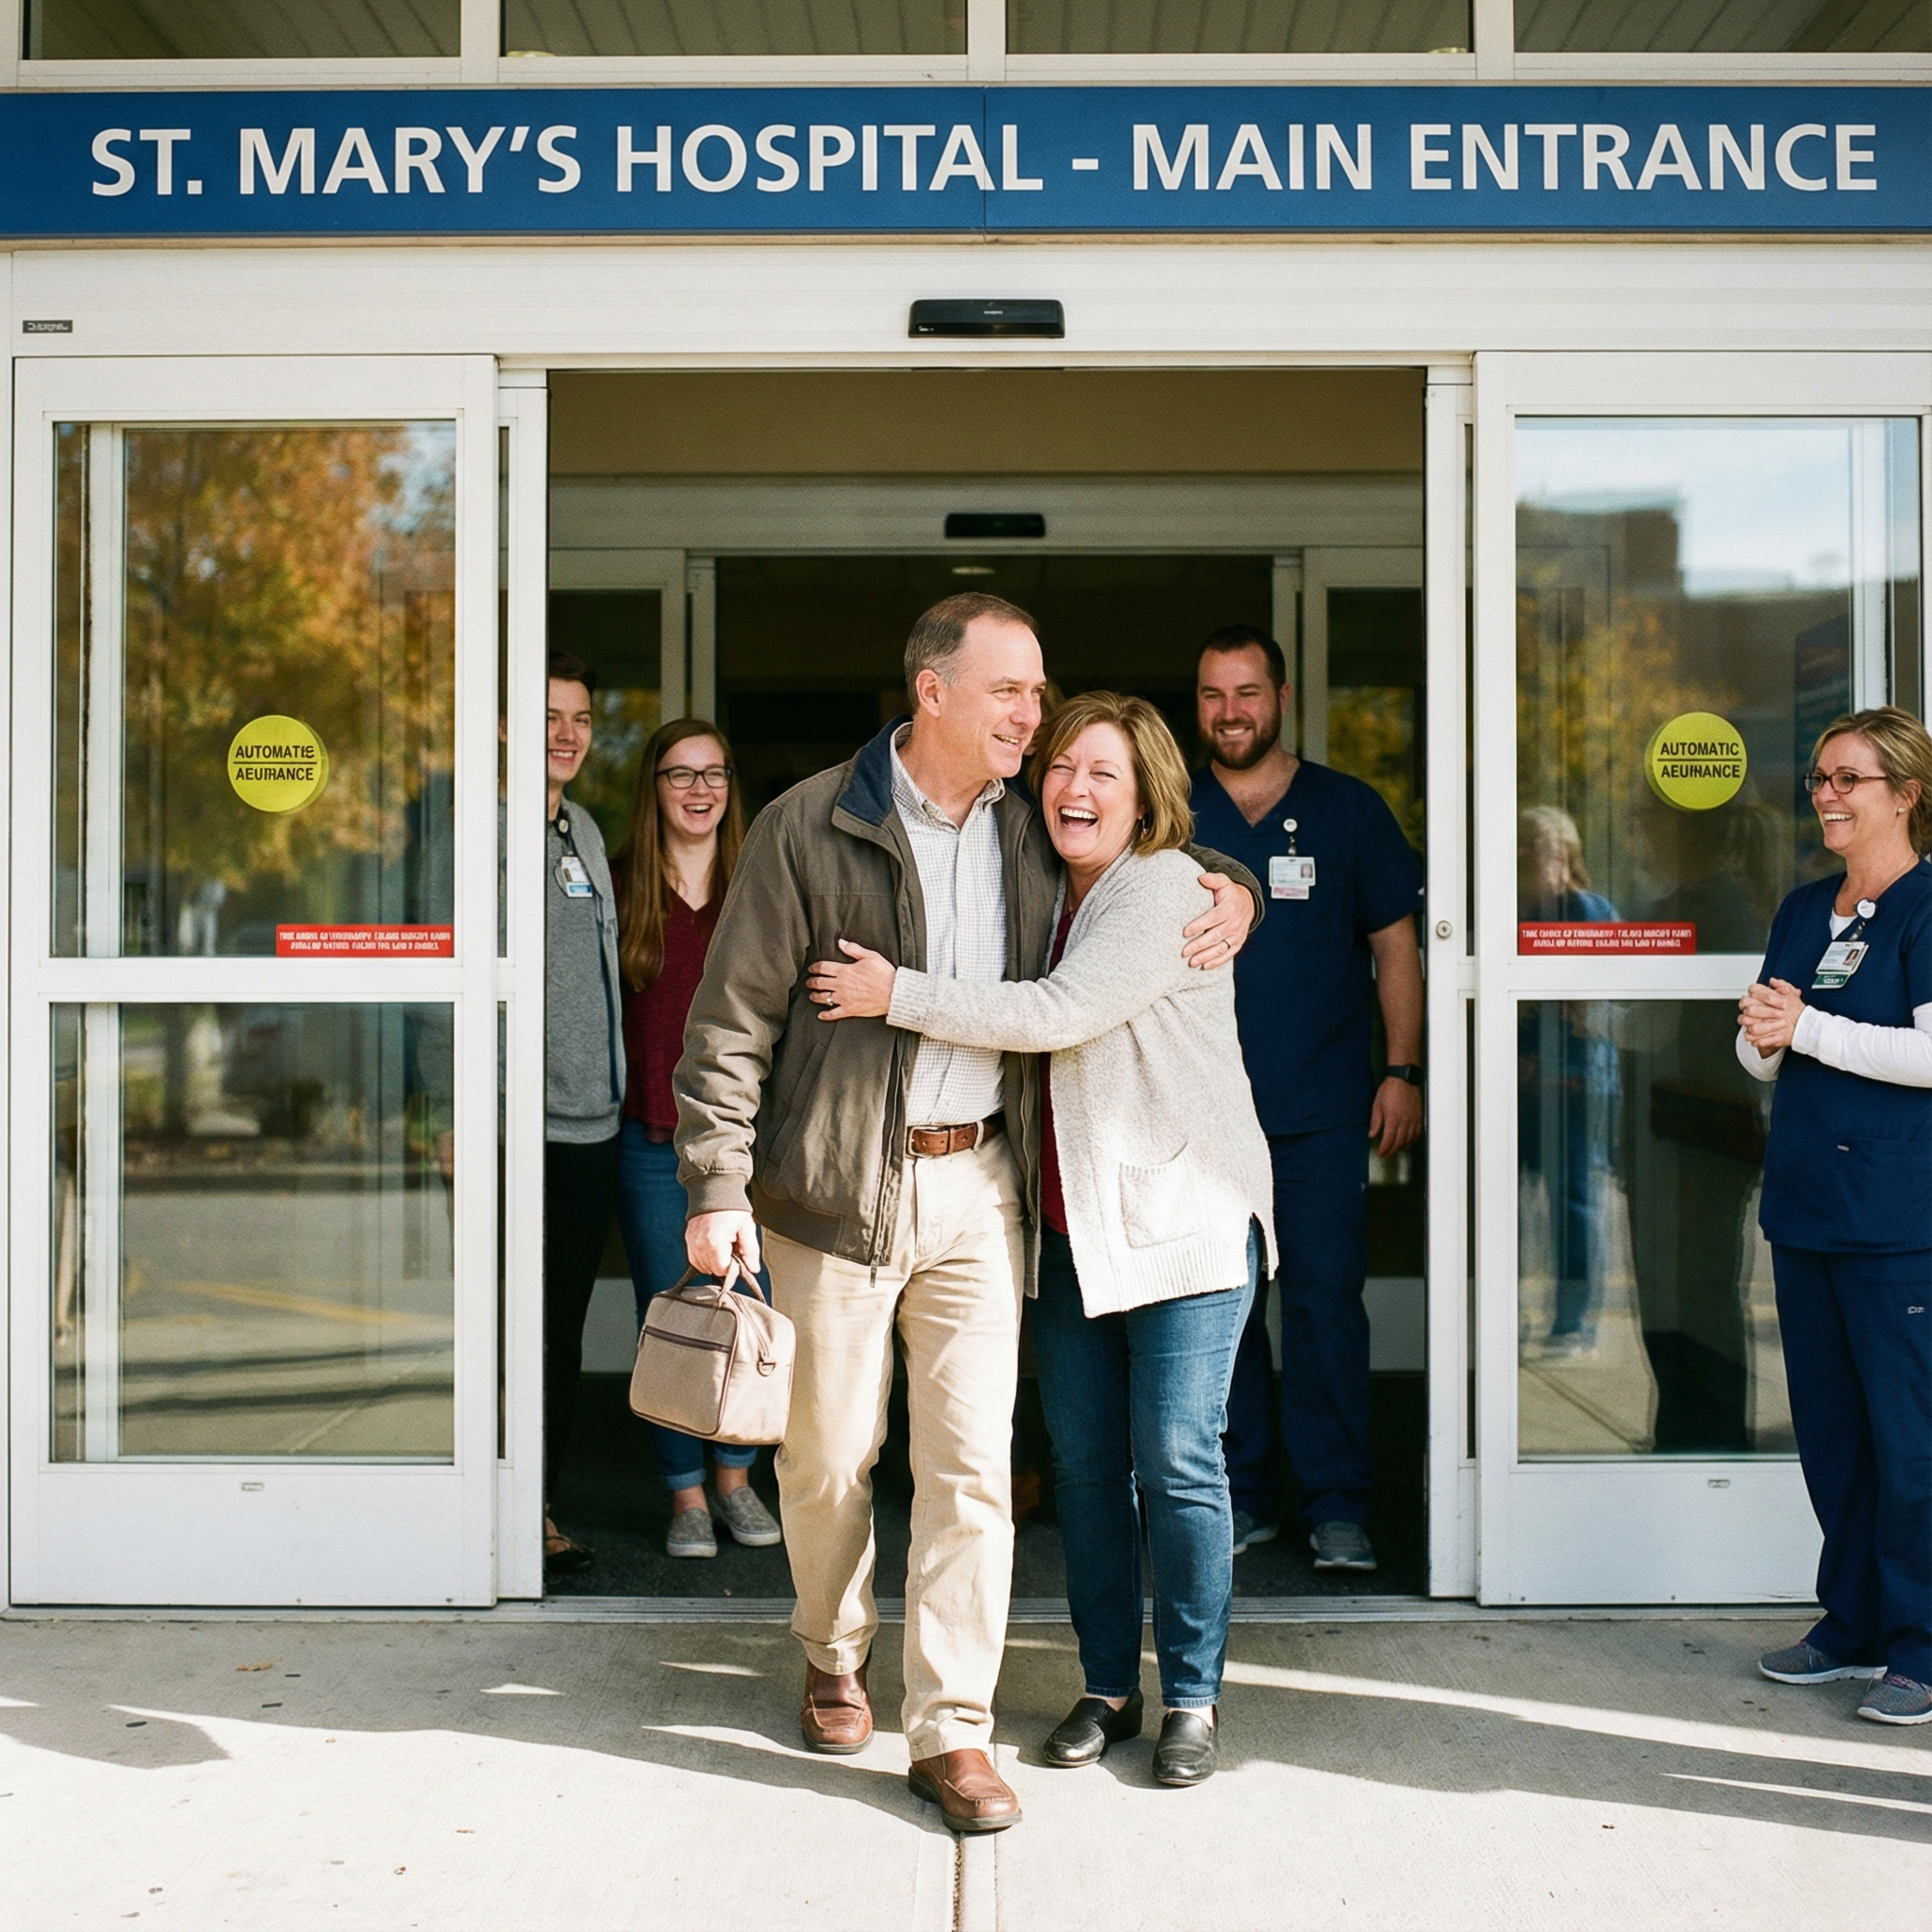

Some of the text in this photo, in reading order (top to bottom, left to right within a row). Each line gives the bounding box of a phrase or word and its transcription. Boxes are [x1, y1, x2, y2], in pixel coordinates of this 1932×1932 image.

[92, 124, 1877, 196] ST. MARY’S HOSPITAL - MAIN ENTRANCE
[1660, 741, 1740, 756] AUTOMATIC
